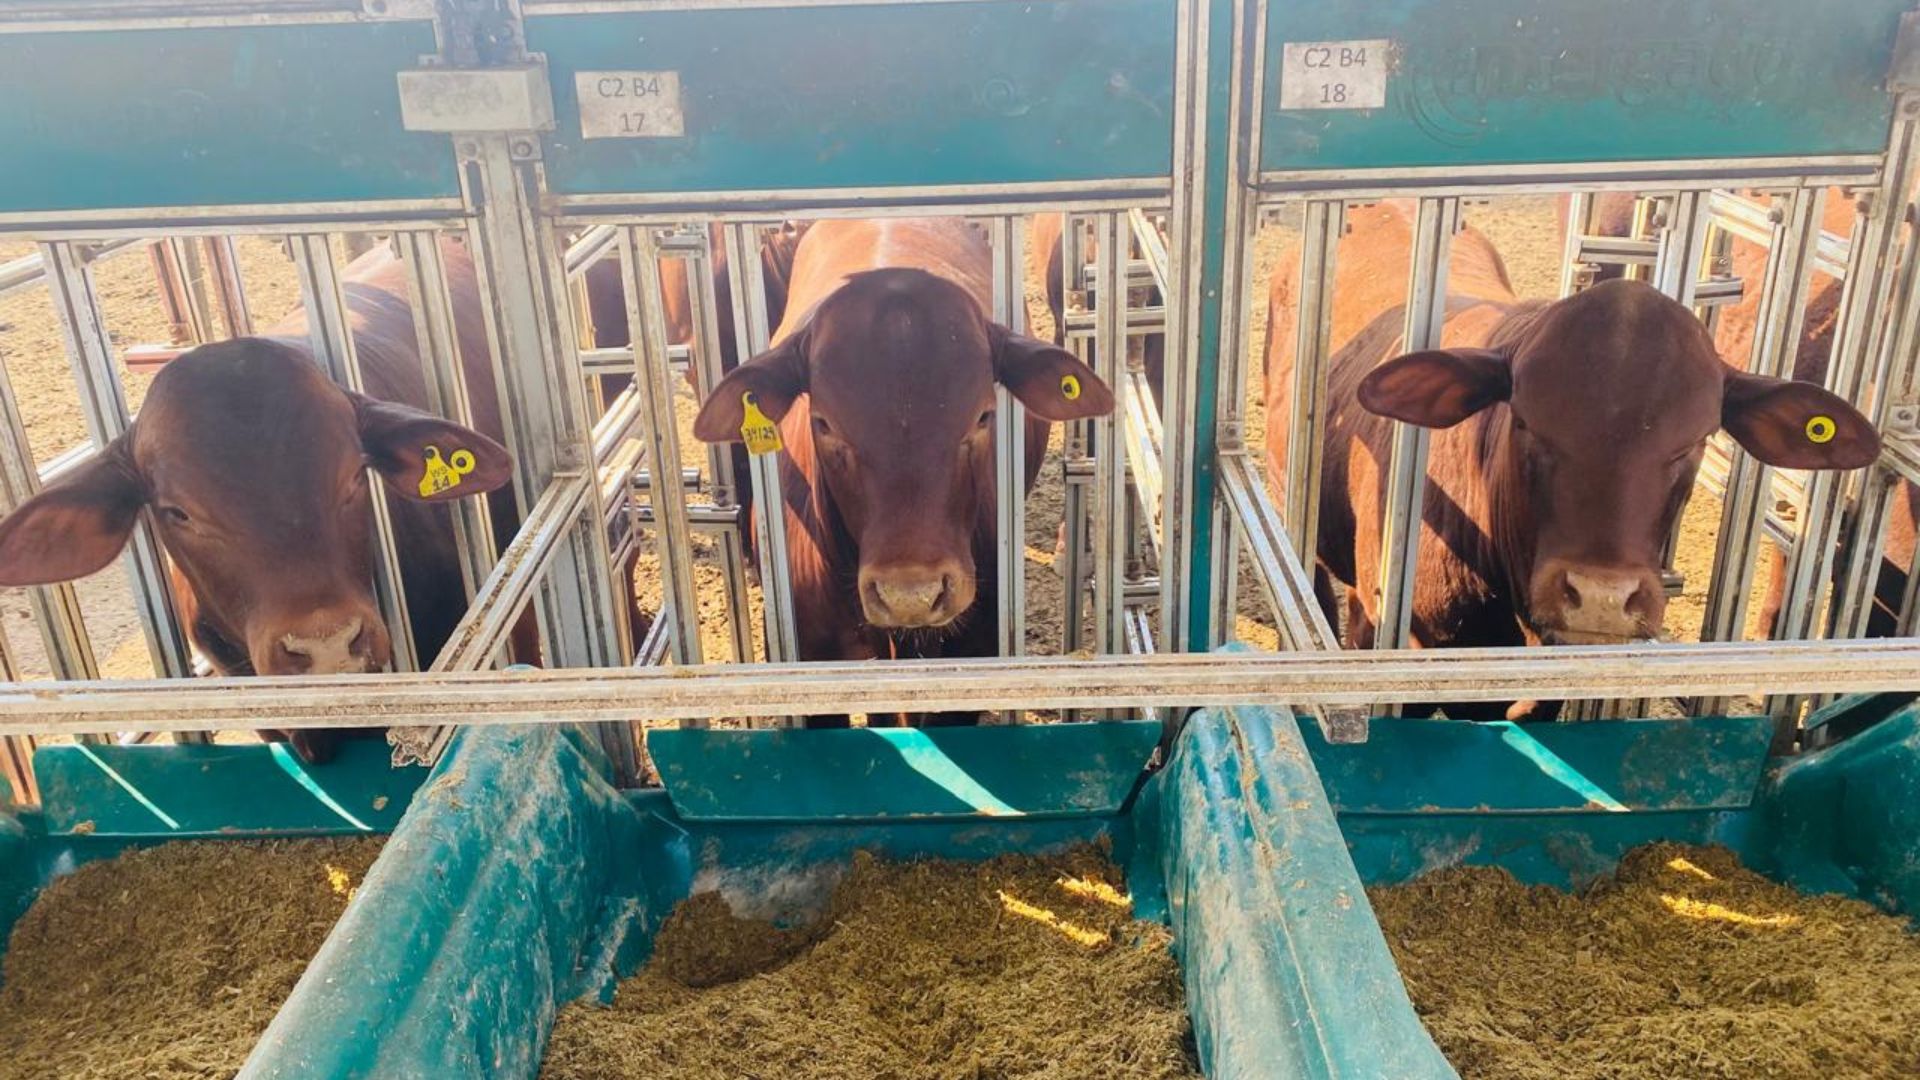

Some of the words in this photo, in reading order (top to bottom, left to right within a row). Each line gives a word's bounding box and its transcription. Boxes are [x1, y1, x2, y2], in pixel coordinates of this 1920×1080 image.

[1304, 47, 1331, 68] C2
[1340, 47, 1367, 67] B4
[598, 77, 625, 98] C2
[633, 76, 660, 97] B4
[1320, 83, 1347, 103] 18
[620, 112, 646, 133] 17
[432, 475, 450, 491] 14
